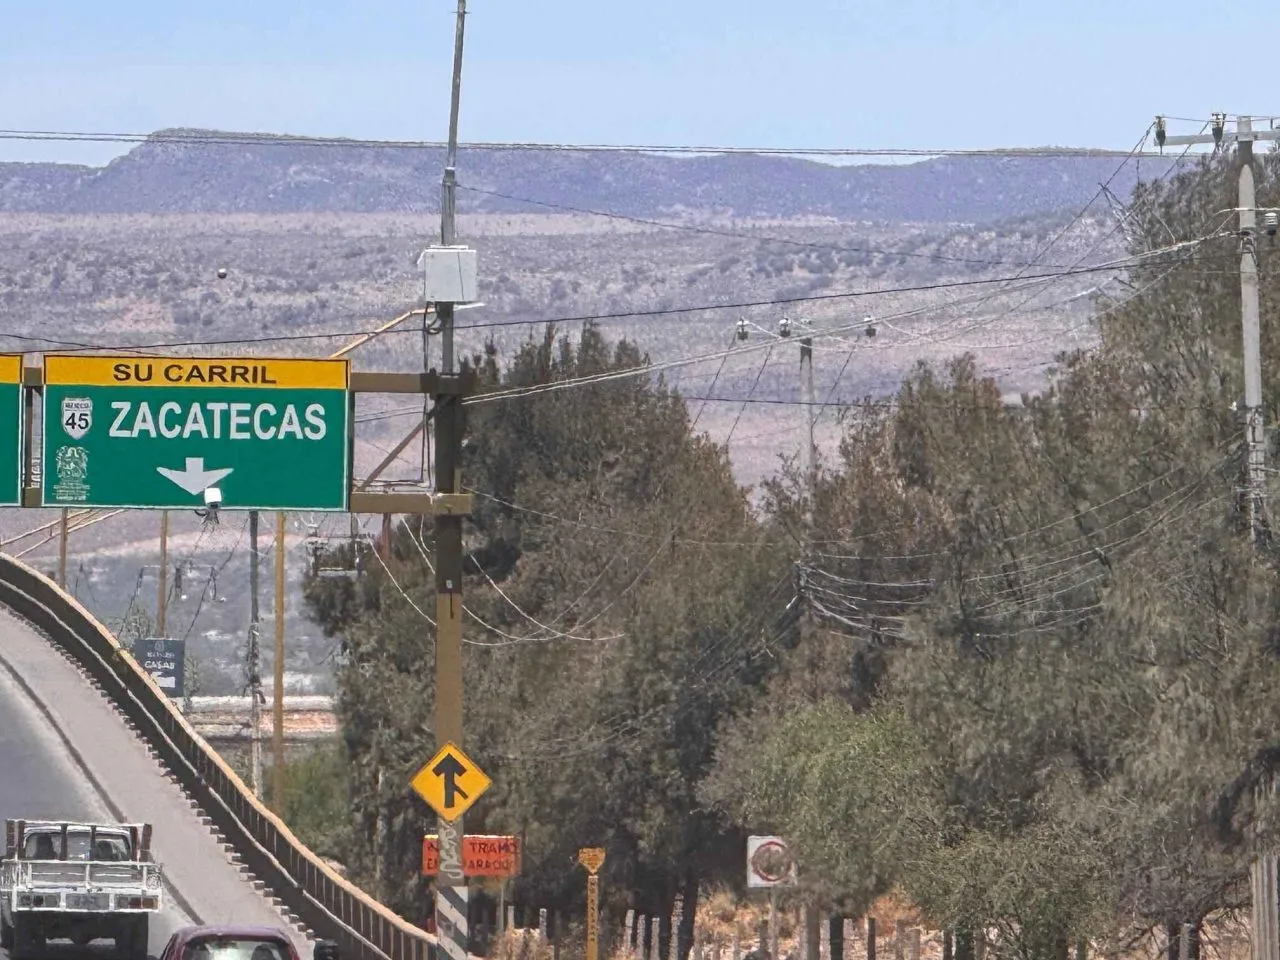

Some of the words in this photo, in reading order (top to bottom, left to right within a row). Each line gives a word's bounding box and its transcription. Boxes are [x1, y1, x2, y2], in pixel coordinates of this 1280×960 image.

[112, 364, 153, 382] SU
[163, 365, 277, 384] CARRIL
[64, 412, 89, 430] 45
[108, 401, 327, 441] ZACATECAS
